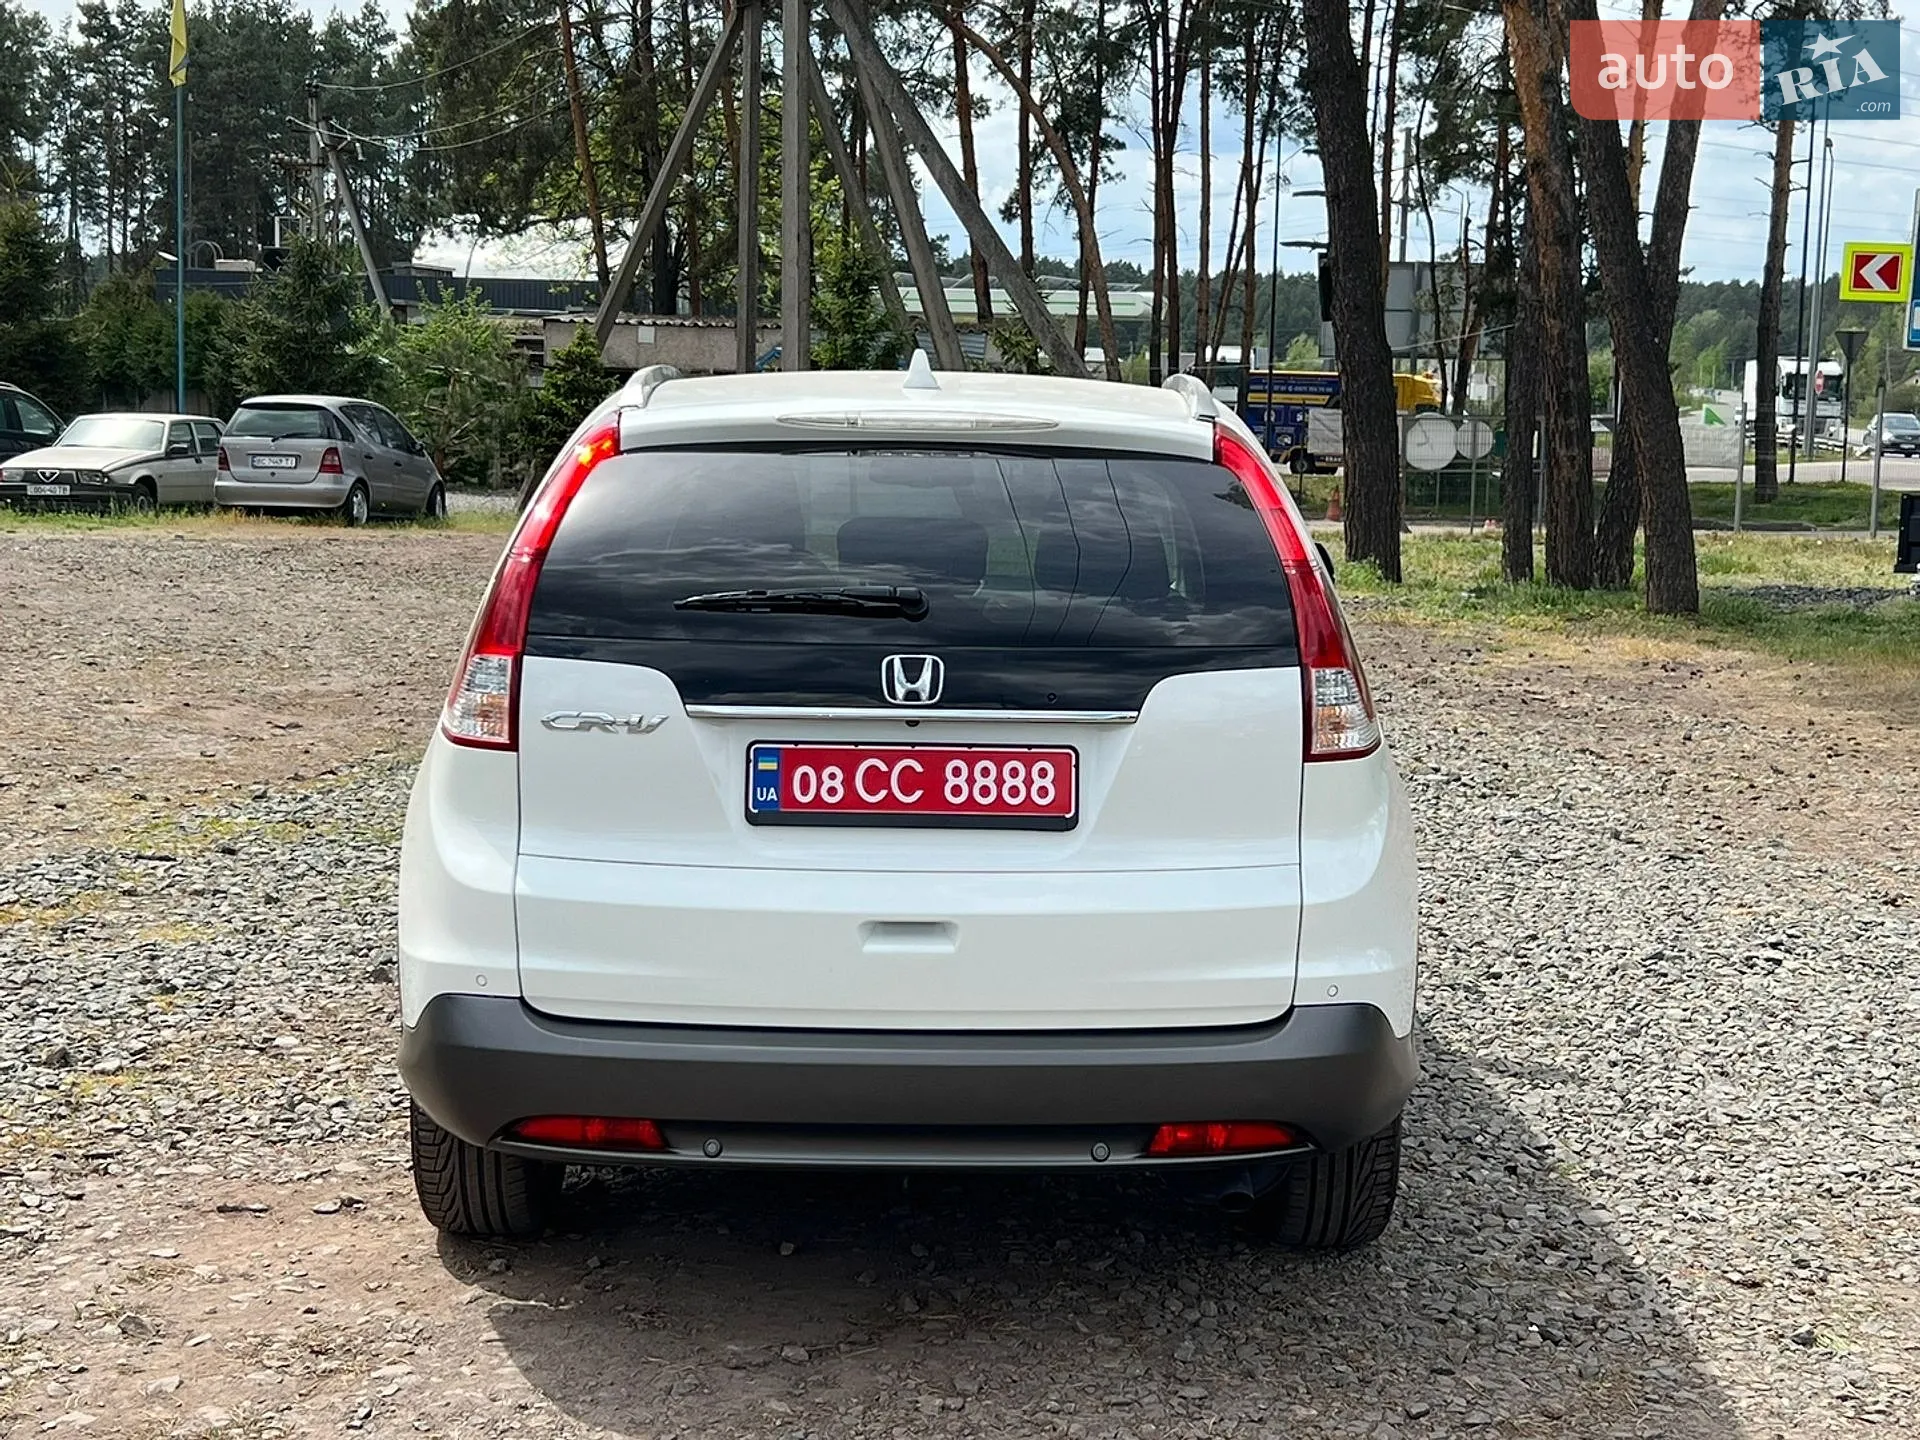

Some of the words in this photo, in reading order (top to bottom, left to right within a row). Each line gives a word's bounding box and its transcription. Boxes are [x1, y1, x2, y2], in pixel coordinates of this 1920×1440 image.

[540, 710, 669, 734] CR-V
[792, 764, 845, 804] 08
[854, 757, 925, 804] CC
[944, 758, 1057, 806] 8888
[756, 787, 778, 801] UA
